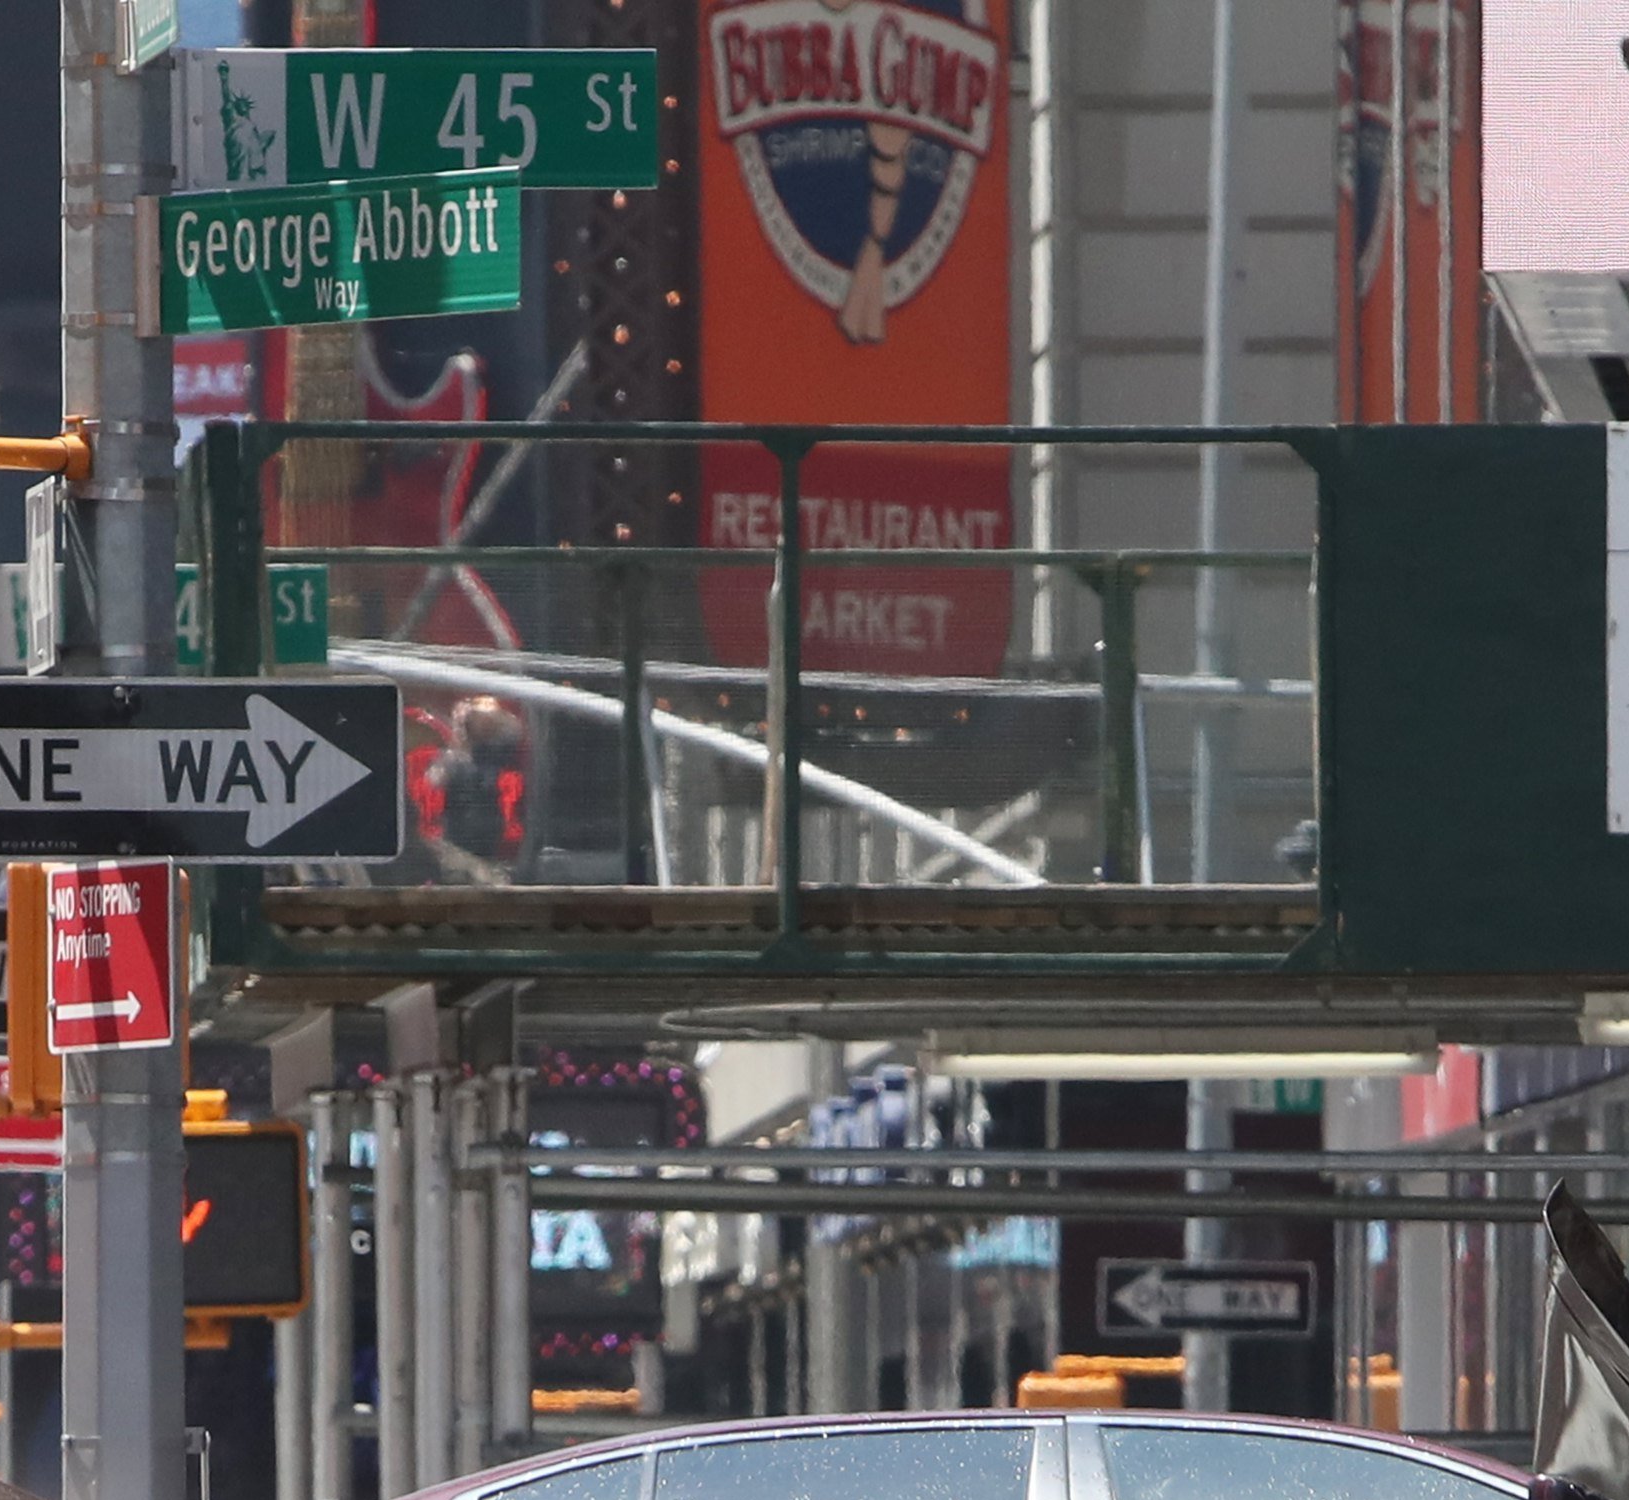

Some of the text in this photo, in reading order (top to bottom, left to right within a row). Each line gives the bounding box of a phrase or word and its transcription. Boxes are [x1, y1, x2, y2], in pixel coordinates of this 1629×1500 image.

[310, 71, 638, 169] W 45 St
[175, 186, 500, 288] George Abbott
[314, 276, 360, 317] Way
[276, 578, 316, 625] St
[804, 590, 955, 650] ARKET
[159, 739, 316, 804] WAY
[55, 881, 142, 920] NO STOPPING
[56, 927, 112, 969] Anytime
